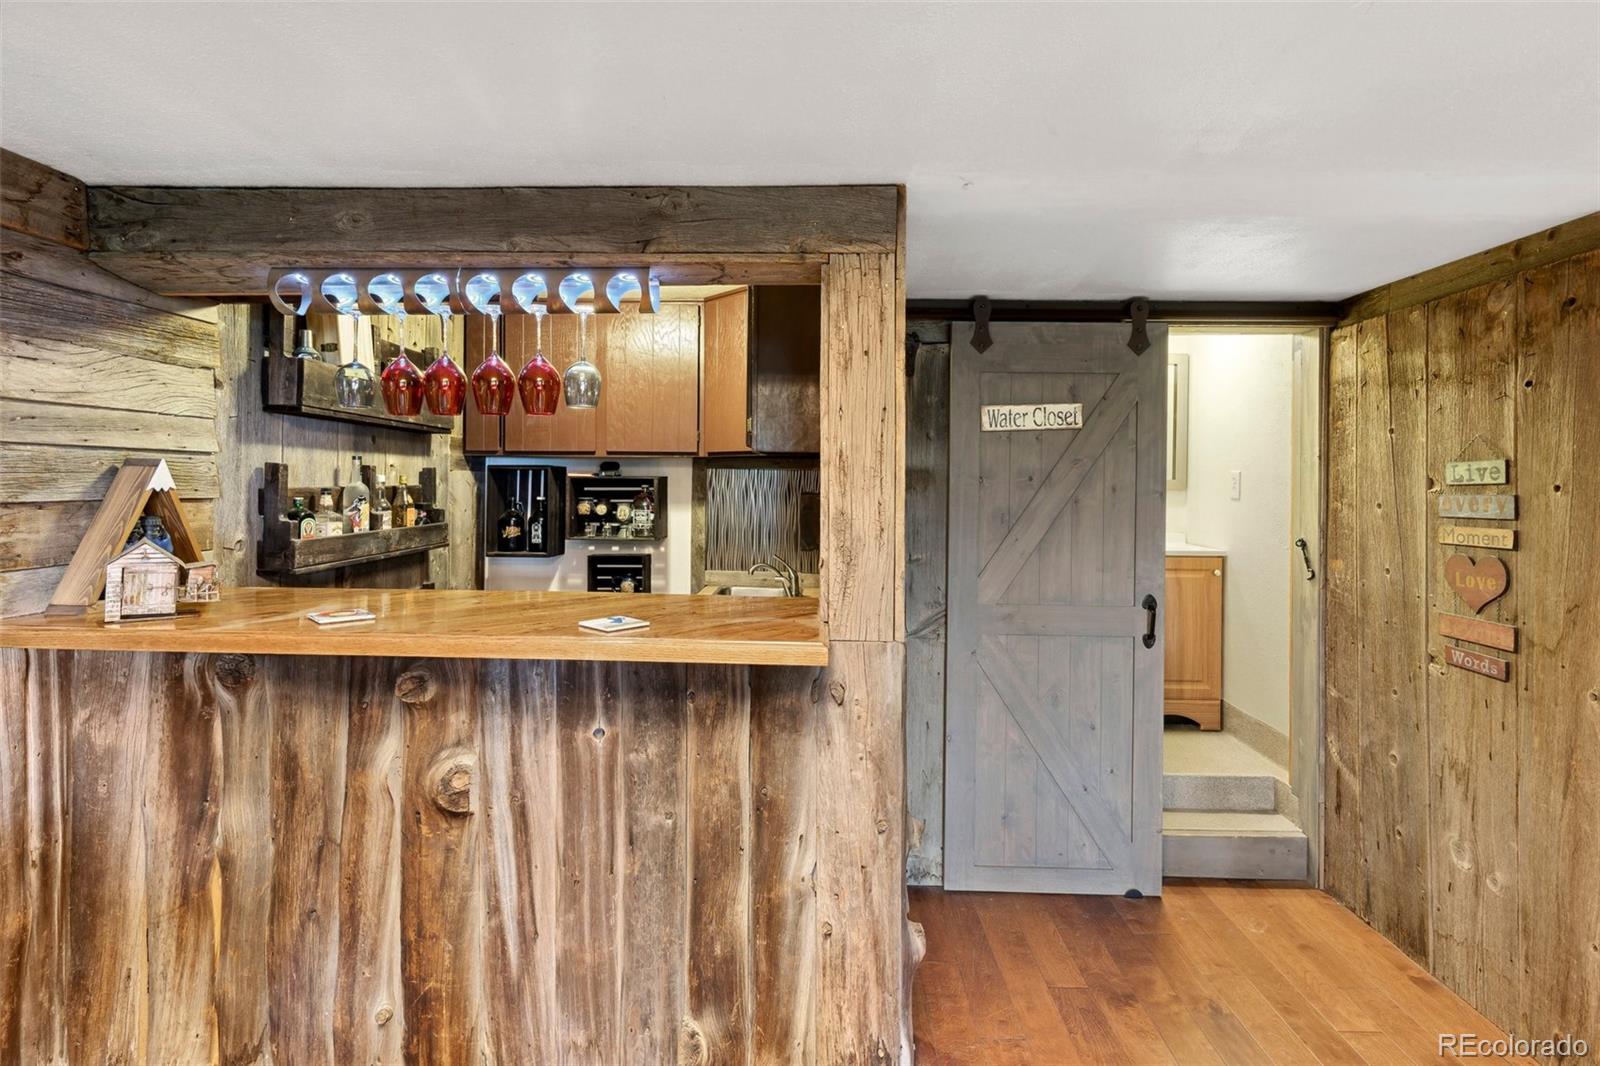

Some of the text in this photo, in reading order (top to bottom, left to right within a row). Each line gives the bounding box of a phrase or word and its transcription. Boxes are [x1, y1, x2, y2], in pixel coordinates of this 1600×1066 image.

[987, 406, 1079, 428] Water Closet
[1450, 464, 1501, 482] Live
[1442, 528, 1508, 546] Moment
[1455, 571, 1497, 590] Love
[1451, 649, 1498, 675] Words
